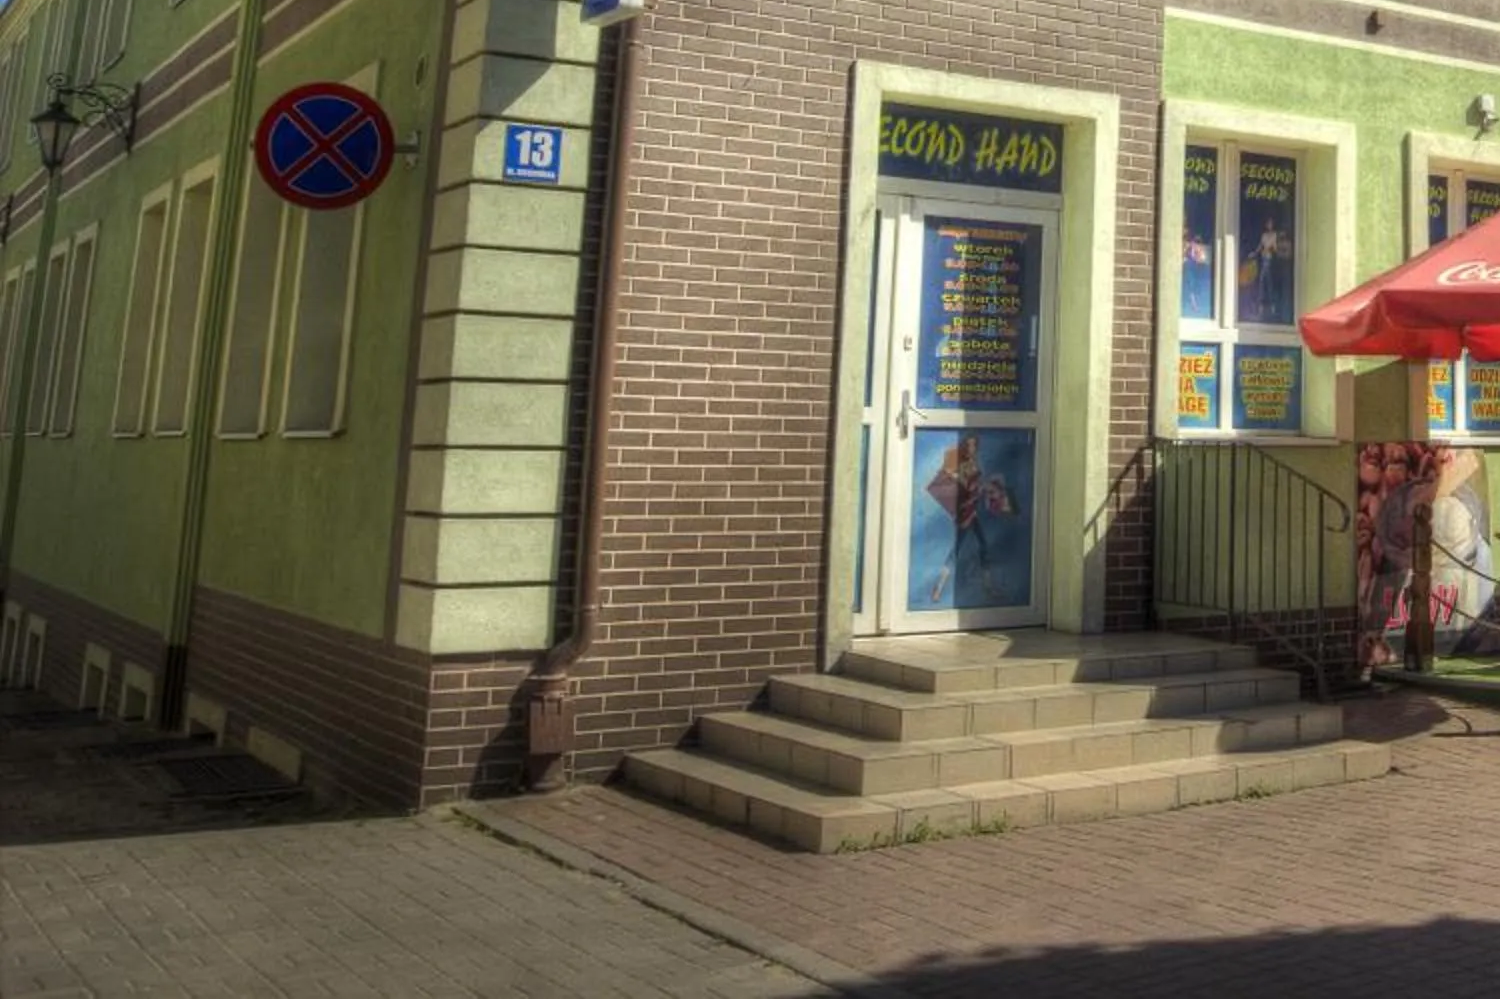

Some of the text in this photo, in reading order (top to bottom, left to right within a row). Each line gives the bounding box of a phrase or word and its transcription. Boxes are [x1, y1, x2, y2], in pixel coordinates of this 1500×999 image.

[515, 131, 553, 167] 13
[880, 112, 1057, 177] ECOND HAND
[1179, 350, 1214, 375] ZIEŻ
